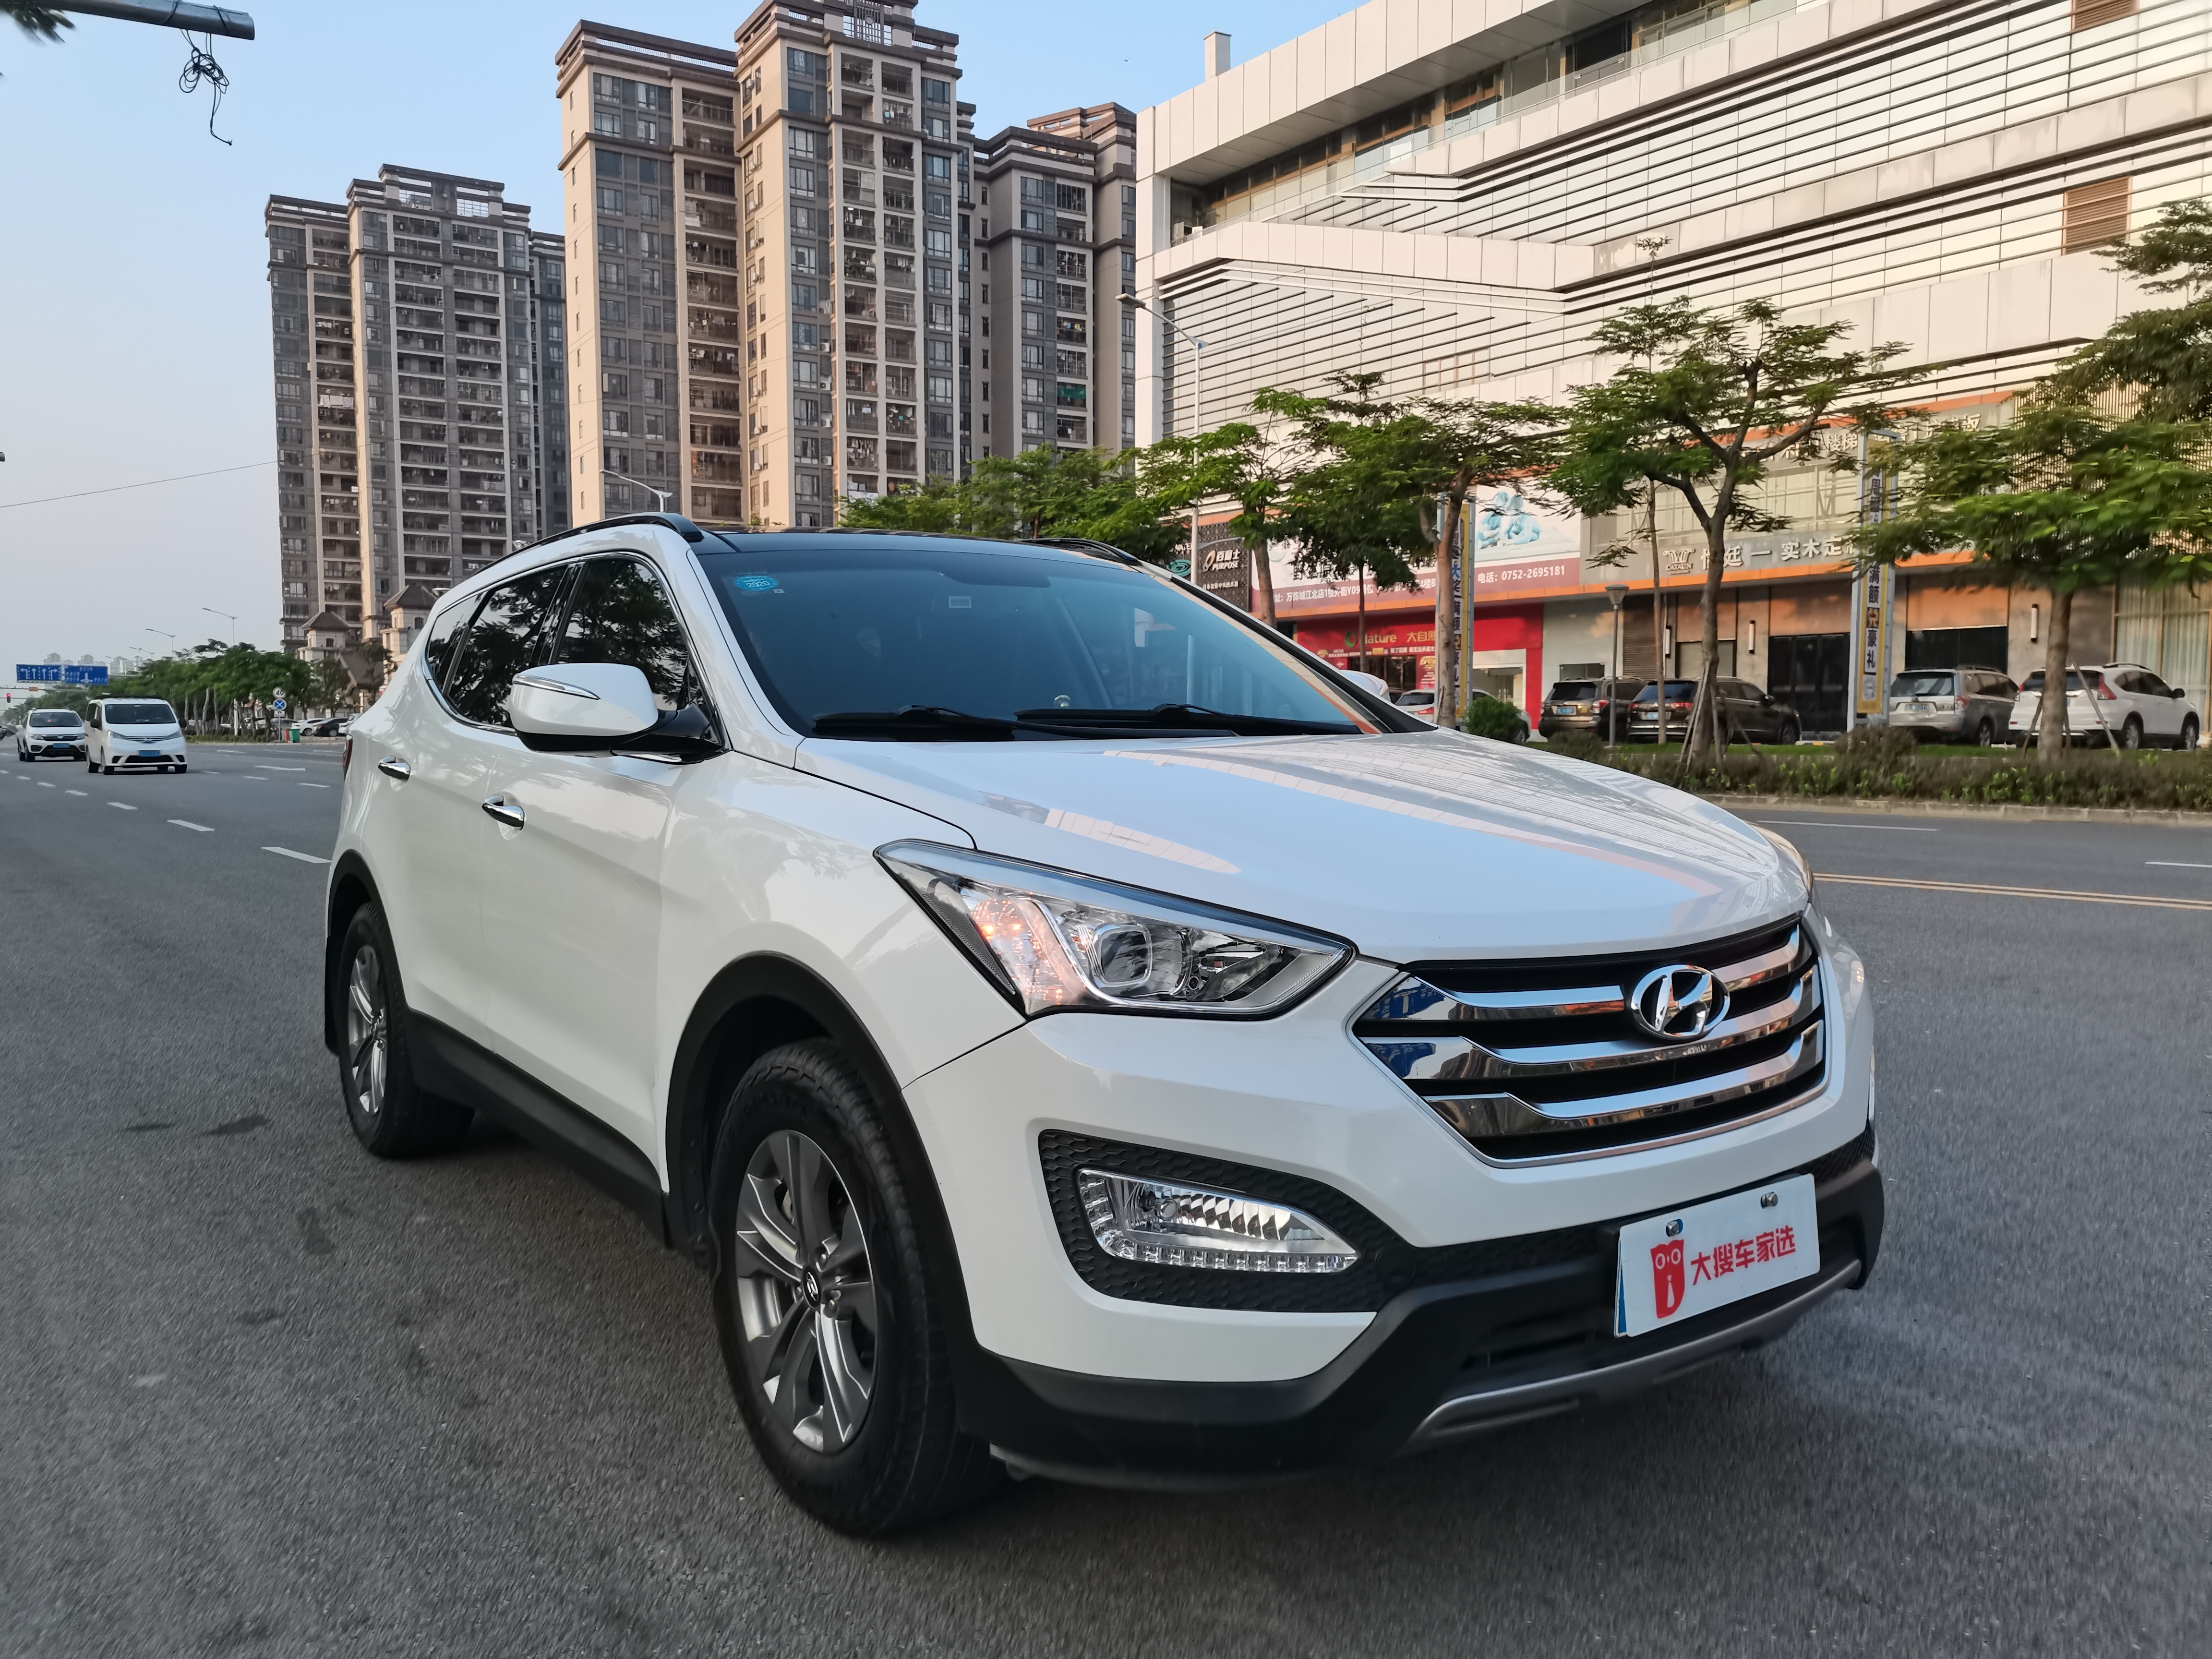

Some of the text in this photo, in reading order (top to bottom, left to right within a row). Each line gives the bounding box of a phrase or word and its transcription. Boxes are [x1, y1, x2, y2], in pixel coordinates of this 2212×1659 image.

[1828, 433, 1858, 451] 楼梯
[1212, 560, 1239, 571] PURPOSE
[1690, 1225, 1796, 1286] 大搜车家选
